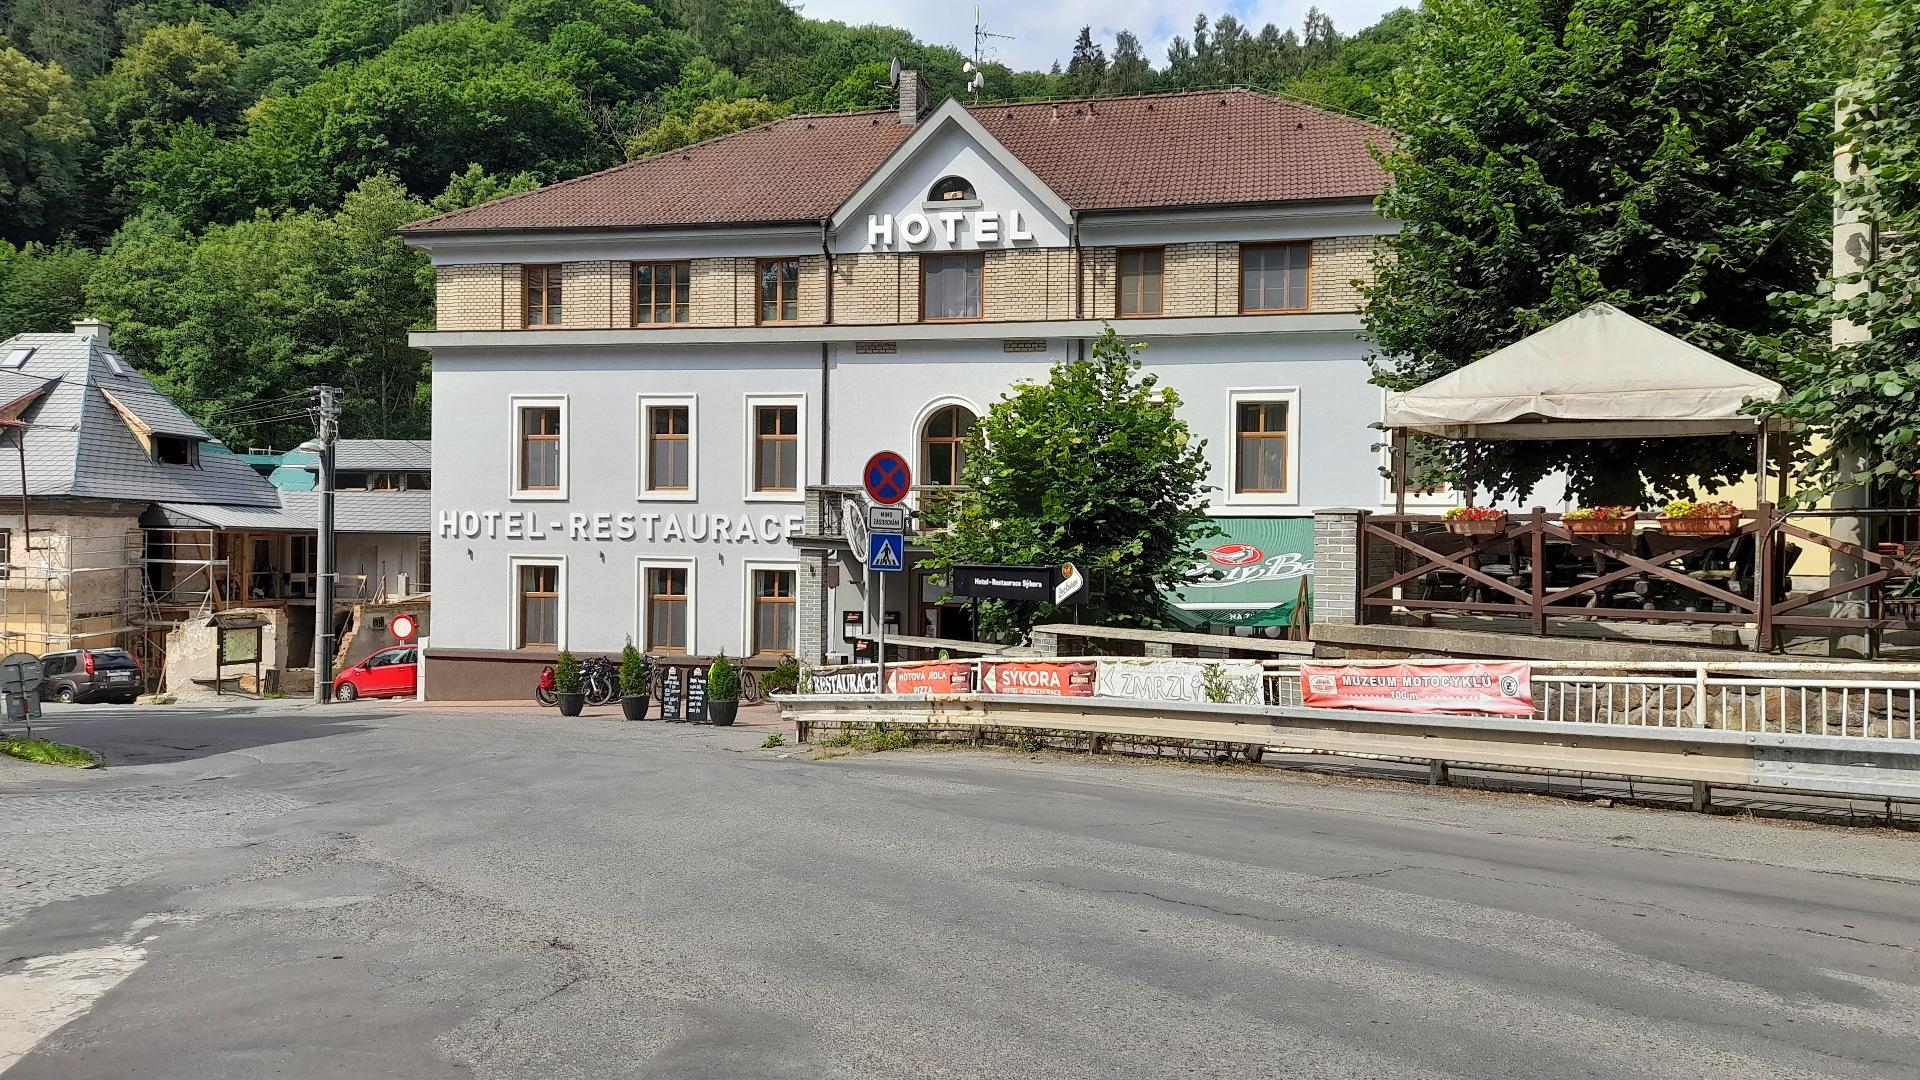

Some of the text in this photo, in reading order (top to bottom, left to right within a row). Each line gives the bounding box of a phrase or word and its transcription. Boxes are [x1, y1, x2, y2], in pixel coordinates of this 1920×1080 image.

[867, 209, 1032, 245] HOTEL
[813, 672, 877, 694] RESTAURACE
[898, 670, 925, 681] HOTOVÁ
[1002, 667, 1061, 687] SÝKORA
[1341, 672, 1493, 688] MUZEUM MOTOCYKLŮ
[913, 685, 933, 694] PIZZA
[1391, 690, 1419, 700] 100 m
